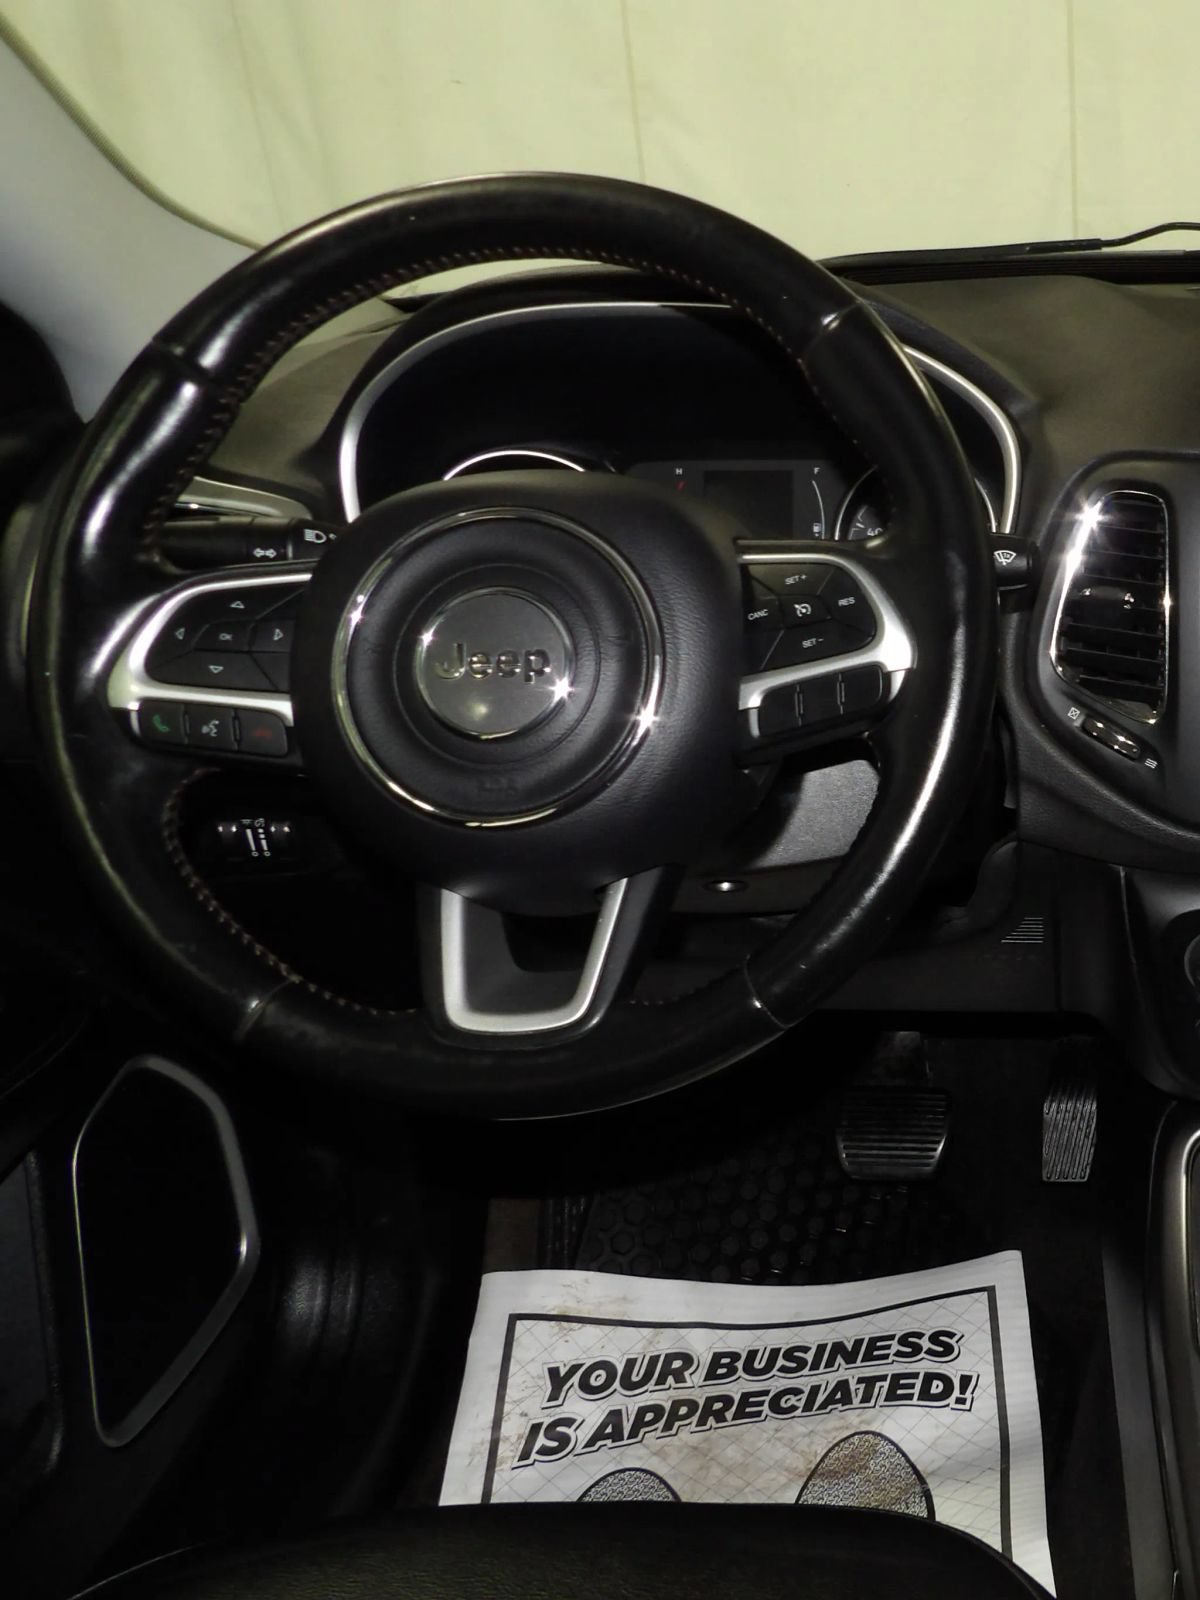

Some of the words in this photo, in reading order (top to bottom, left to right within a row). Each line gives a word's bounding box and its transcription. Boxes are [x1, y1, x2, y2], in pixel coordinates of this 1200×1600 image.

[814, 467, 820, 475] F
[784, 576, 800, 585] SET
[837, 597, 856, 607] RES
[747, 609, 769, 621] CANC
[801, 638, 817, 648] SET
[434, 642, 553, 685] Jeep
[542, 1350, 700, 1409] YOUR
[702, 1329, 965, 1387] BUSINESS
[511, 1417, 580, 1467] IS
[582, 1371, 979, 1454] APPRECIATED!
